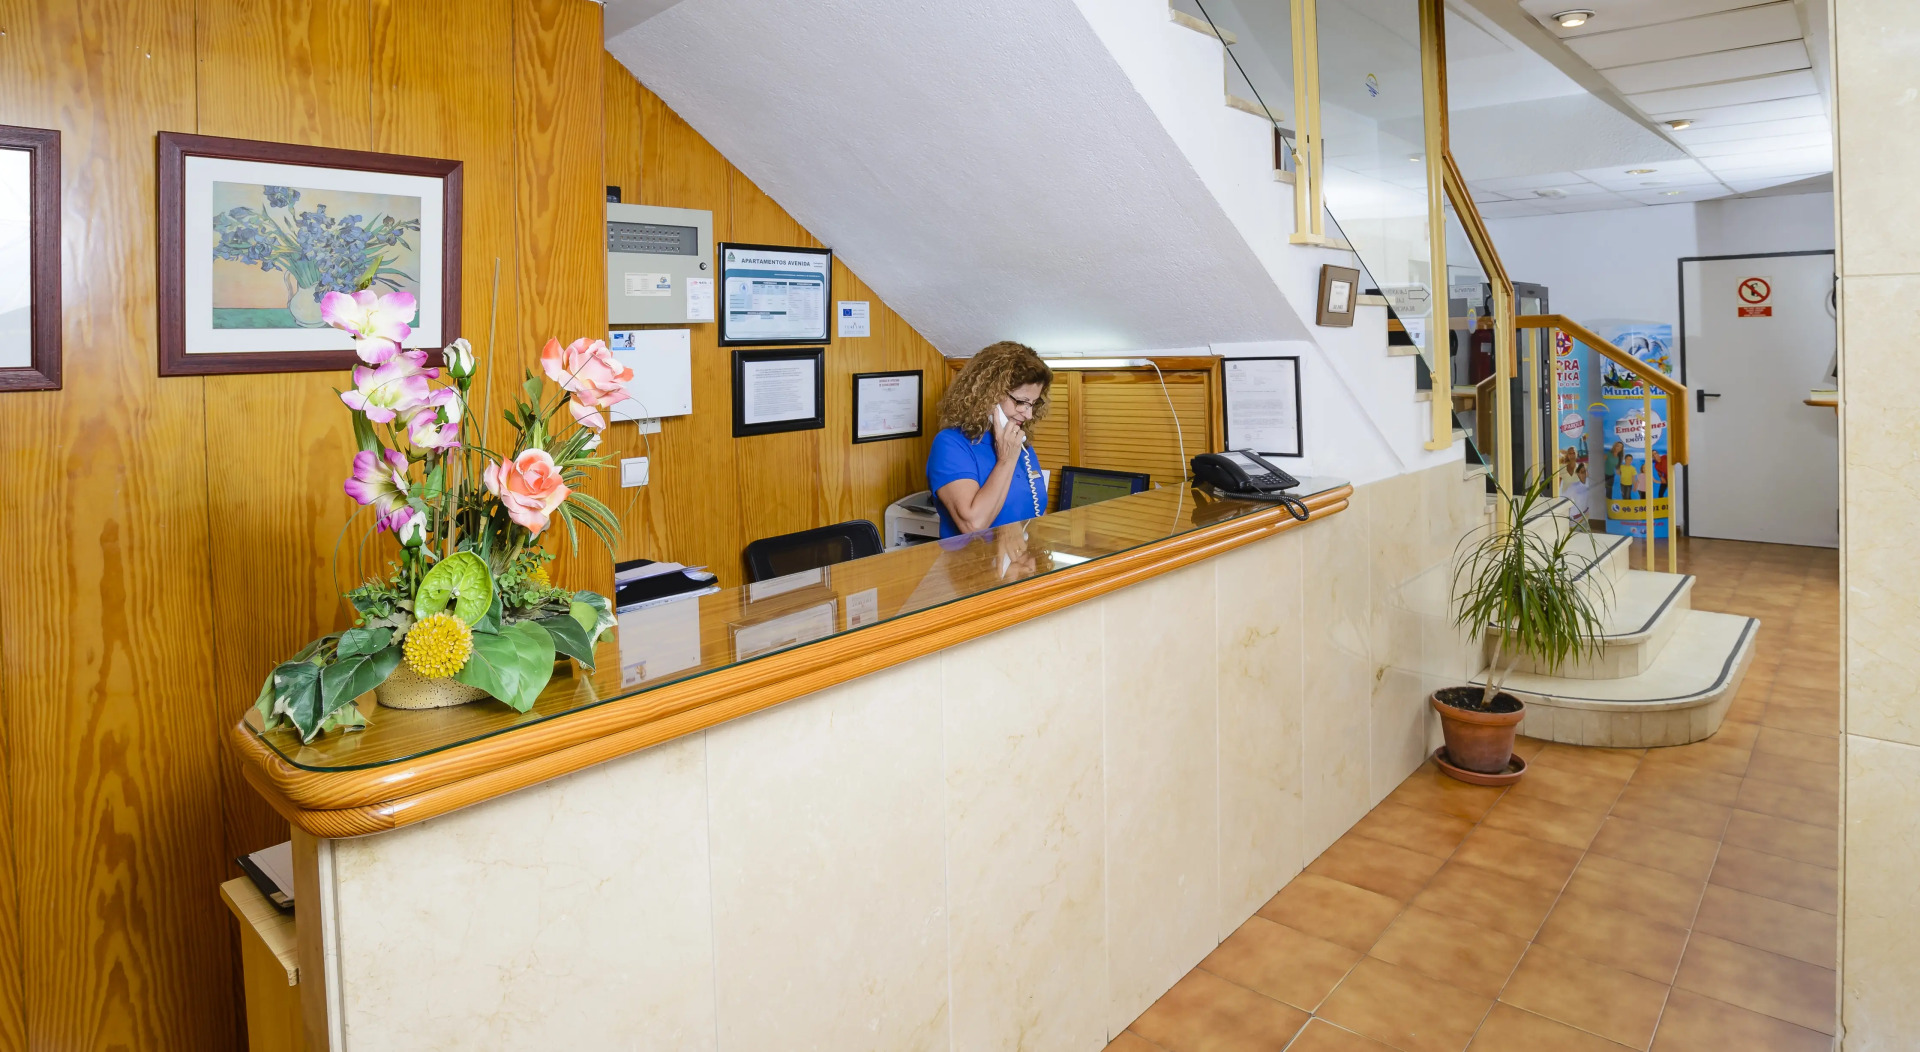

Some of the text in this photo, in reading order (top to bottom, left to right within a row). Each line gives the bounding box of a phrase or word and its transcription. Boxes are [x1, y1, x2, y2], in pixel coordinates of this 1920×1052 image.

[741, 258, 786, 266] APARTAMENTOS
[1556, 372, 1580, 381] TICA
[1604, 387, 1667, 396] MundoMa
